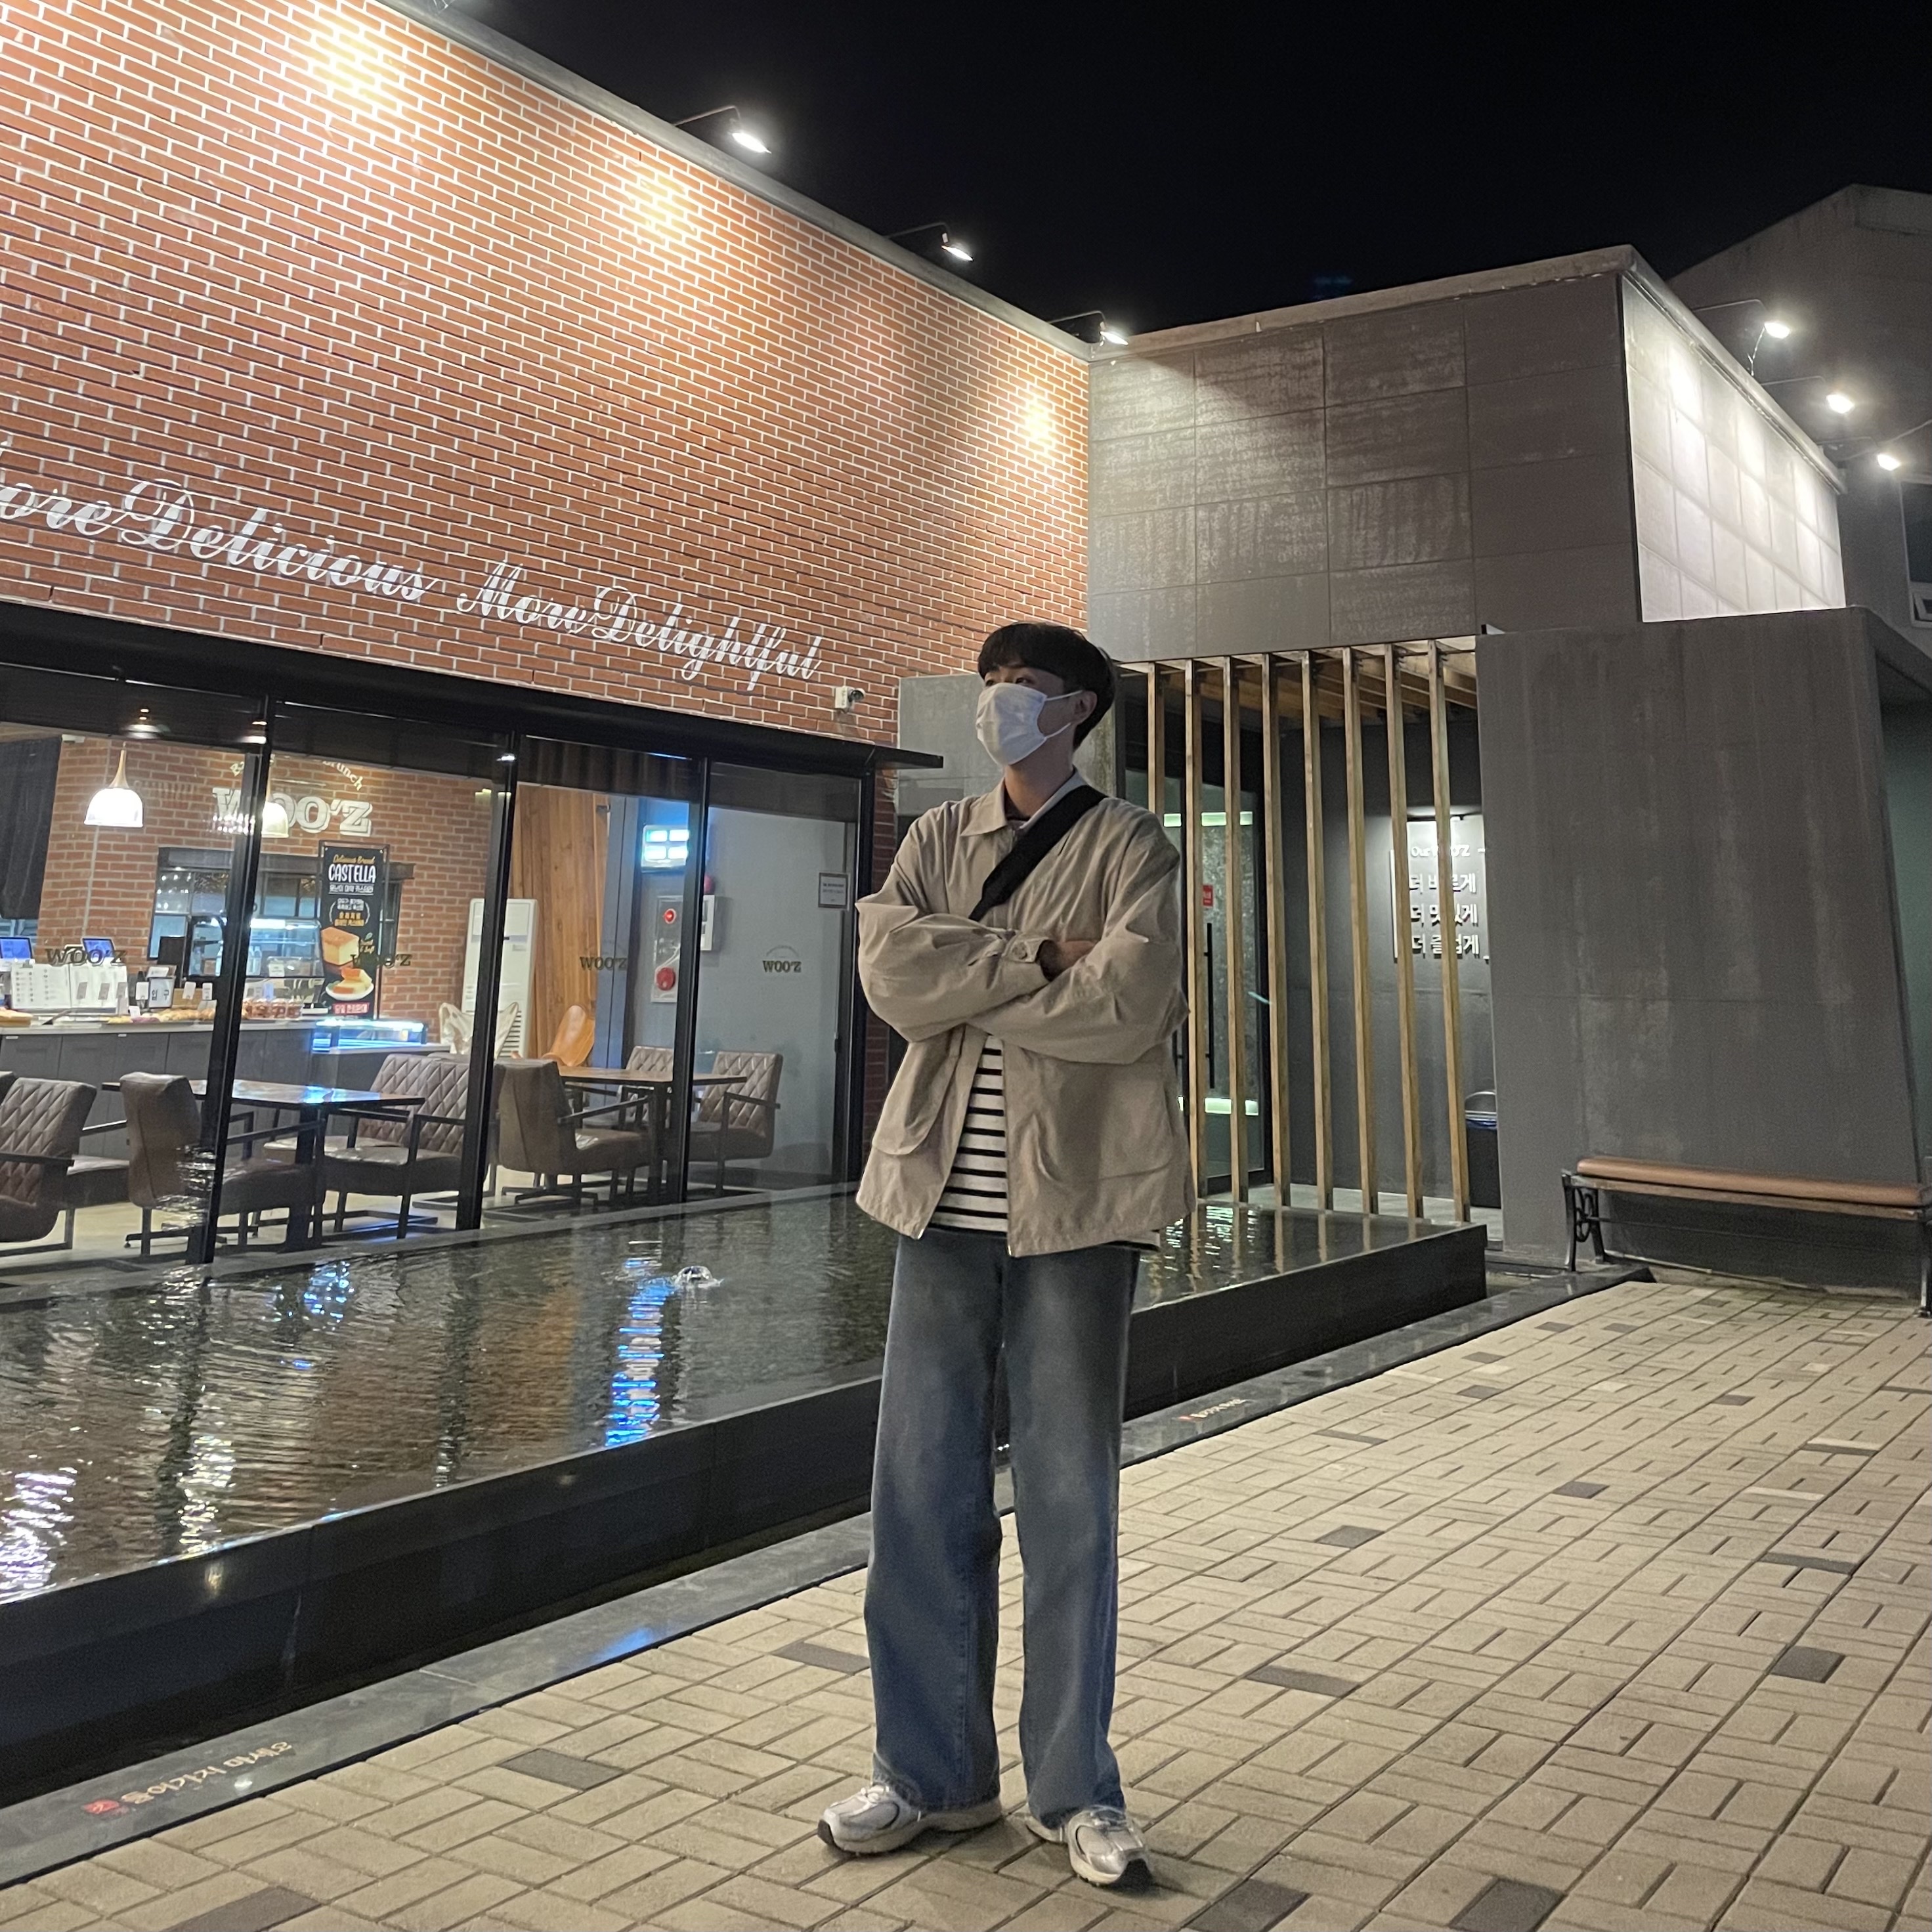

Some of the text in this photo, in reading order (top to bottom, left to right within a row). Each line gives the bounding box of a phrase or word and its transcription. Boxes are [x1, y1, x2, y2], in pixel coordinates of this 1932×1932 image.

[328, 863, 377, 884] CASTELLA
[1410, 903, 1425, 924] 더
[1411, 933, 1426, 954] 더
[762, 960, 802, 973] WOO'Z
